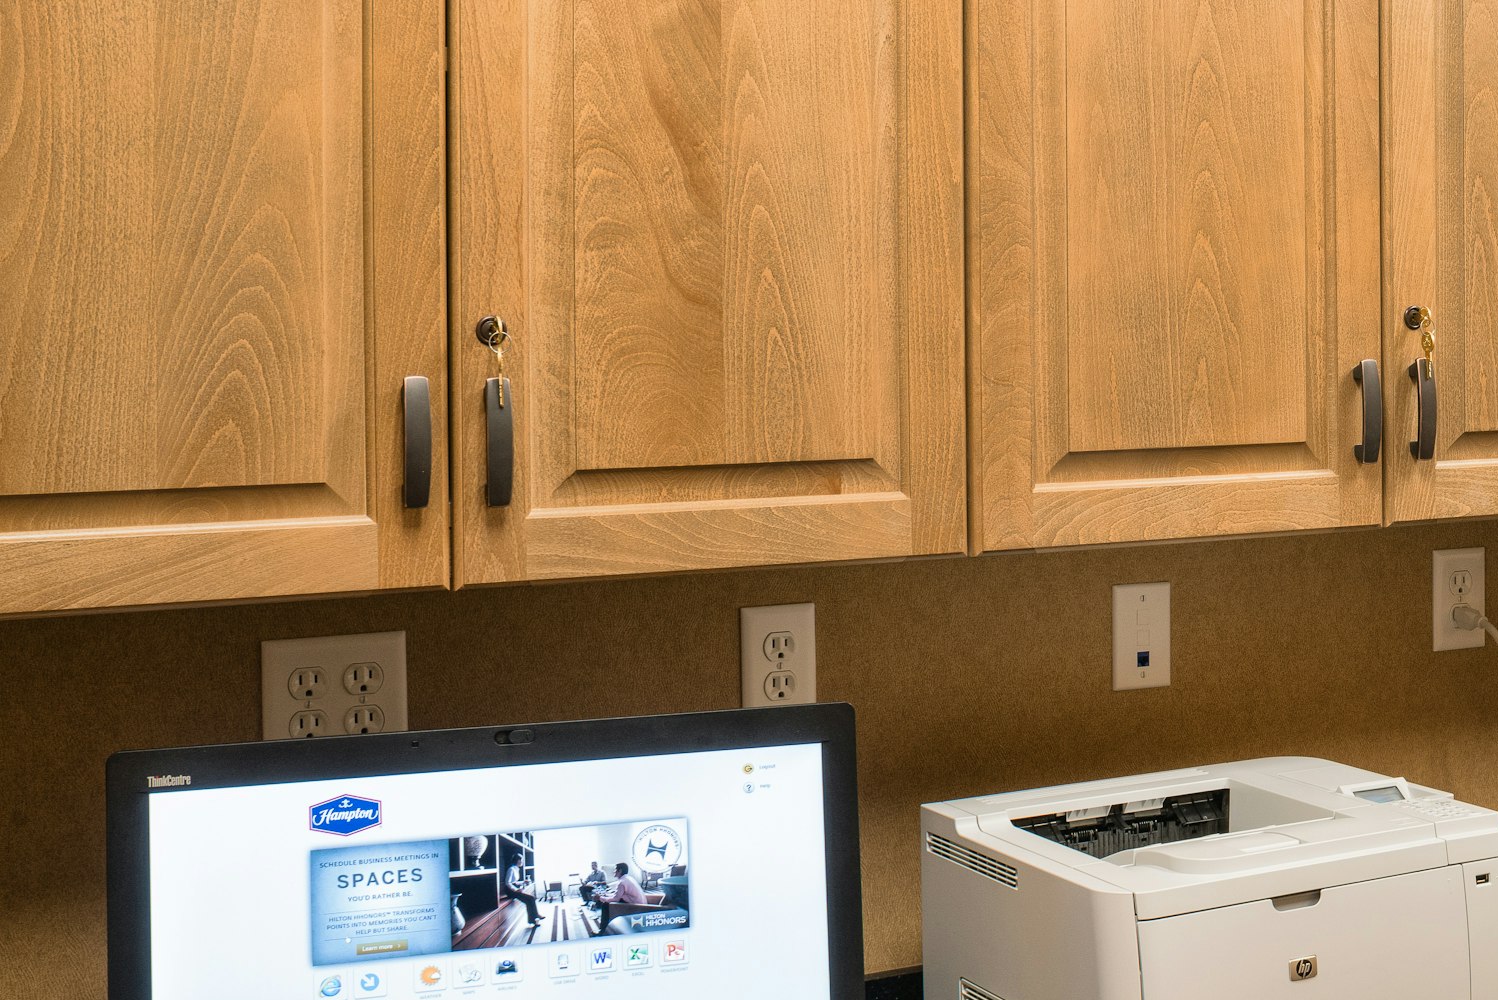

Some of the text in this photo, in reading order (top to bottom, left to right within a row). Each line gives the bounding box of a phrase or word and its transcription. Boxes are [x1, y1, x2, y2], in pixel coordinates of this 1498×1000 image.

[147, 774, 191, 788] ThinkCentre
[312, 806, 379, 824] Hampton
[320, 860, 357, 869] SCHEDULE
[358, 857, 393, 865] BUSINESS
[394, 853, 430, 862] MEETINGS
[337, 868, 423, 889] SPACES
[372, 892, 401, 900] RATHER
[392, 907, 435, 916] TRANSFORMS
[368, 918, 403, 926] MEMORIES
[645, 916, 687, 927] HHONORS
[1298, 960, 1311, 978] hp
